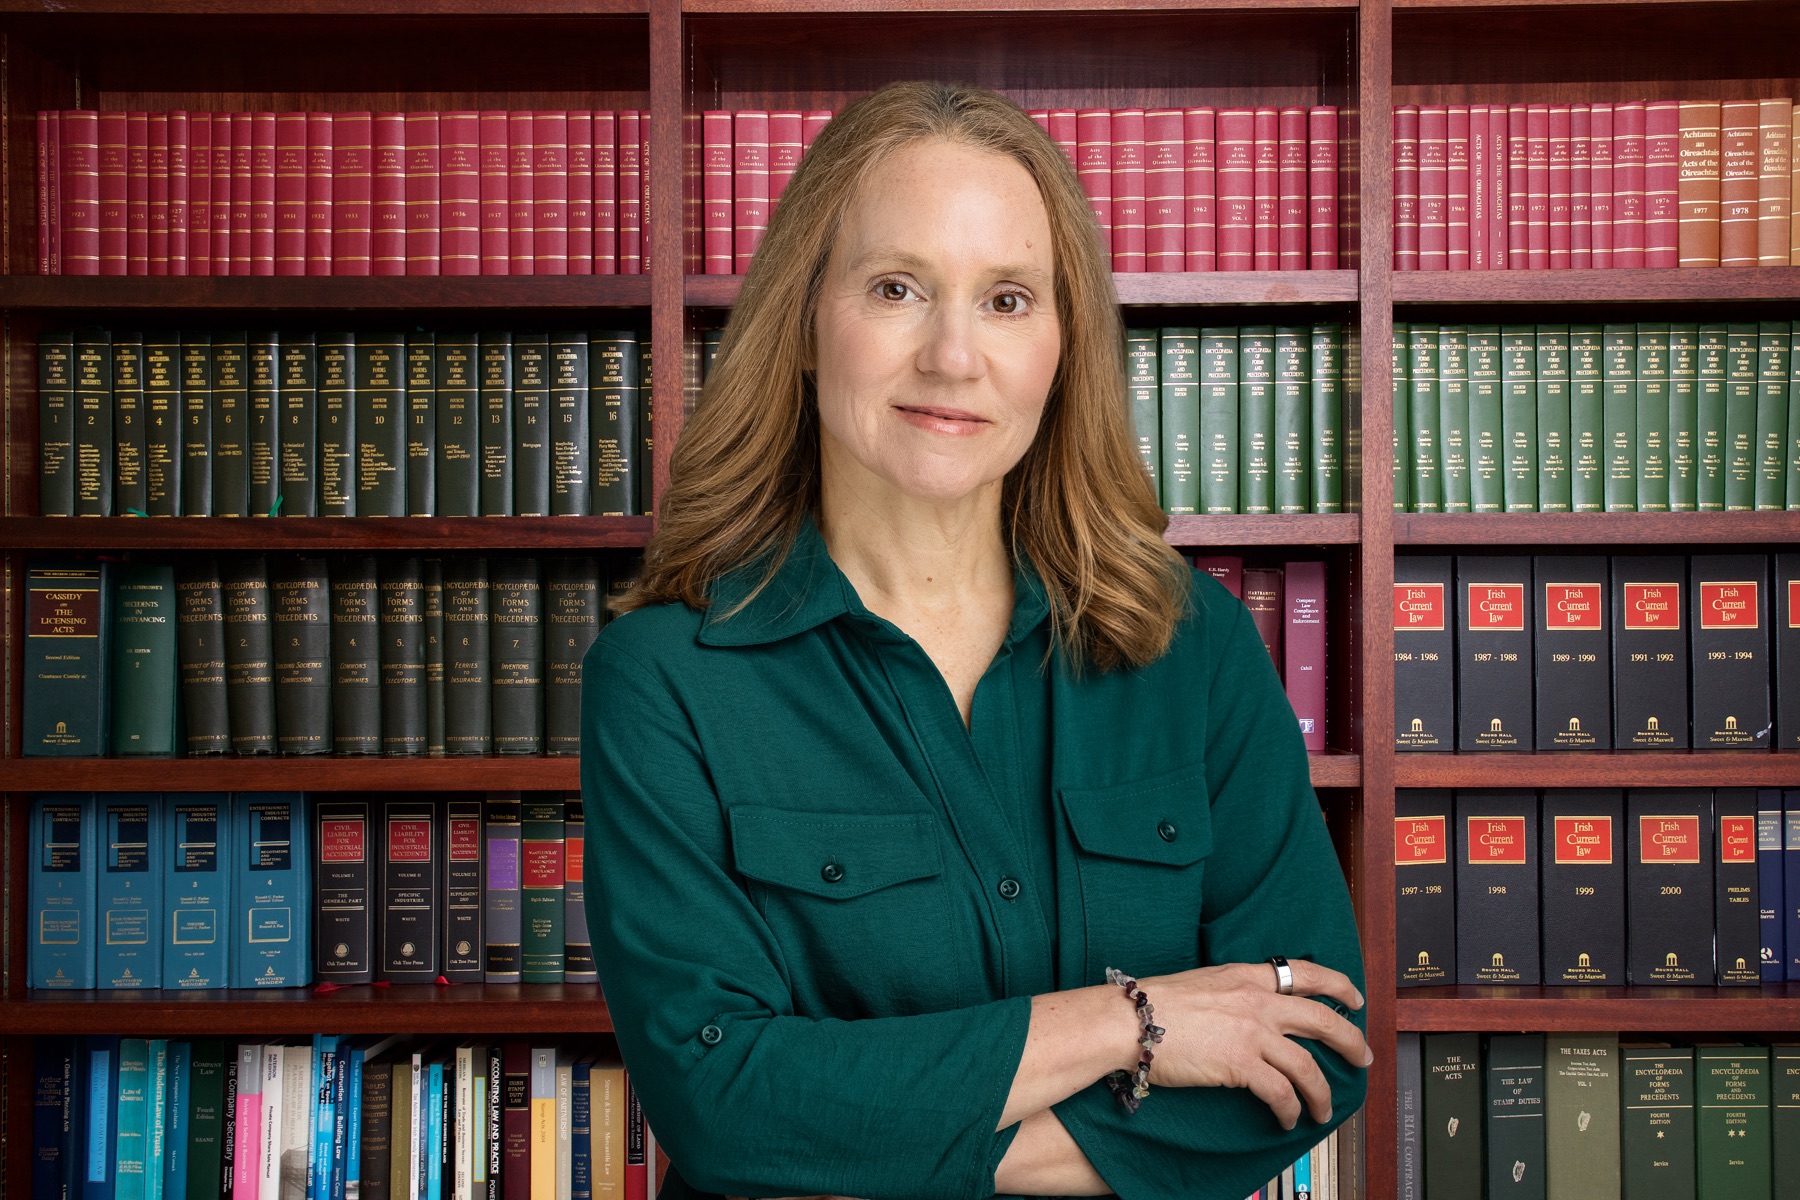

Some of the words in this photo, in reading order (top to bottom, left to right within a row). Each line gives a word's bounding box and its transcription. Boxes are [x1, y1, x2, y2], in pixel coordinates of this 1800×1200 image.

[125, 416, 131, 424] 3
[375, 416, 384, 424] 10
[609, 412, 617, 420] 16
[1407, 589, 1426, 600] Irish
[1487, 589, 1506, 600] Irish
[1565, 589, 1583, 599] Irish
[1643, 589, 1661, 599] Irish
[1720, 588, 1739, 598] Irish
[502, 598, 529, 606] FORMS
[1400, 600, 1432, 612] Current
[1480, 600, 1512, 612] Current
[1557, 600, 1590, 612] Current
[1636, 600, 1668, 611] Current
[1712, 599, 1745, 610] Current
[41, 617, 87, 625] LICENSING
[494, 614, 538, 623] PRECEDENTS
[1409, 612, 1424, 623] Law
[1489, 612, 1504, 622] Law
[1567, 612, 1581, 622] Law
[1645, 611, 1659, 622] Law
[1722, 610, 1736, 621] Law
[1394, 653, 1412, 661] 1984
[1420, 653, 1438, 661] 1986
[1474, 653, 1492, 661] 1987
[1500, 653, 1517, 661] 1988
[1552, 654, 1570, 662] 1989
[1578, 654, 1596, 662] 1990
[1631, 654, 1648, 662] 1991
[1656, 654, 1674, 662] 1992
[1708, 652, 1726, 660] 1993
[1734, 652, 1752, 660] 1994
[1412, 822, 1429, 833] Irish
[1487, 823, 1506, 833] Irish
[1574, 822, 1593, 833] Irish
[1660, 821, 1680, 833] Irish
[1405, 833, 1435, 845] Current
[1480, 834, 1514, 845] Current
[1566, 834, 1600, 845] Current
[1652, 833, 1687, 845] Current
[1727, 836, 1748, 844] Current
[1414, 845, 1427, 856] Law
[1489, 845, 1504, 856] Law
[1576, 845, 1591, 856] Law
[1662, 845, 1678, 856] Law
[1401, 887, 1418, 895] 1997
[1425, 886, 1442, 894] 1998
[1488, 886, 1506, 894] 1998
[1575, 887, 1594, 895] 1999
[1661, 886, 1681, 895] 2000
[230, 1062, 238, 1075] The
[157, 1068, 165, 1101] Modern
[337, 1060, 345, 1101] Construction
[226, 1080, 237, 1118] Company
[1404, 1090, 1413, 1110] THE
[156, 1102, 164, 1118] Law
[157, 1120, 163, 1129] of
[335, 1116, 343, 1144] Building
[1405, 1114, 1415, 1142] RIAI
[154, 1130, 163, 1156] Trusts
[225, 1122, 235, 1160] Secretary
[491, 1142, 499, 1174] PRACTICE
